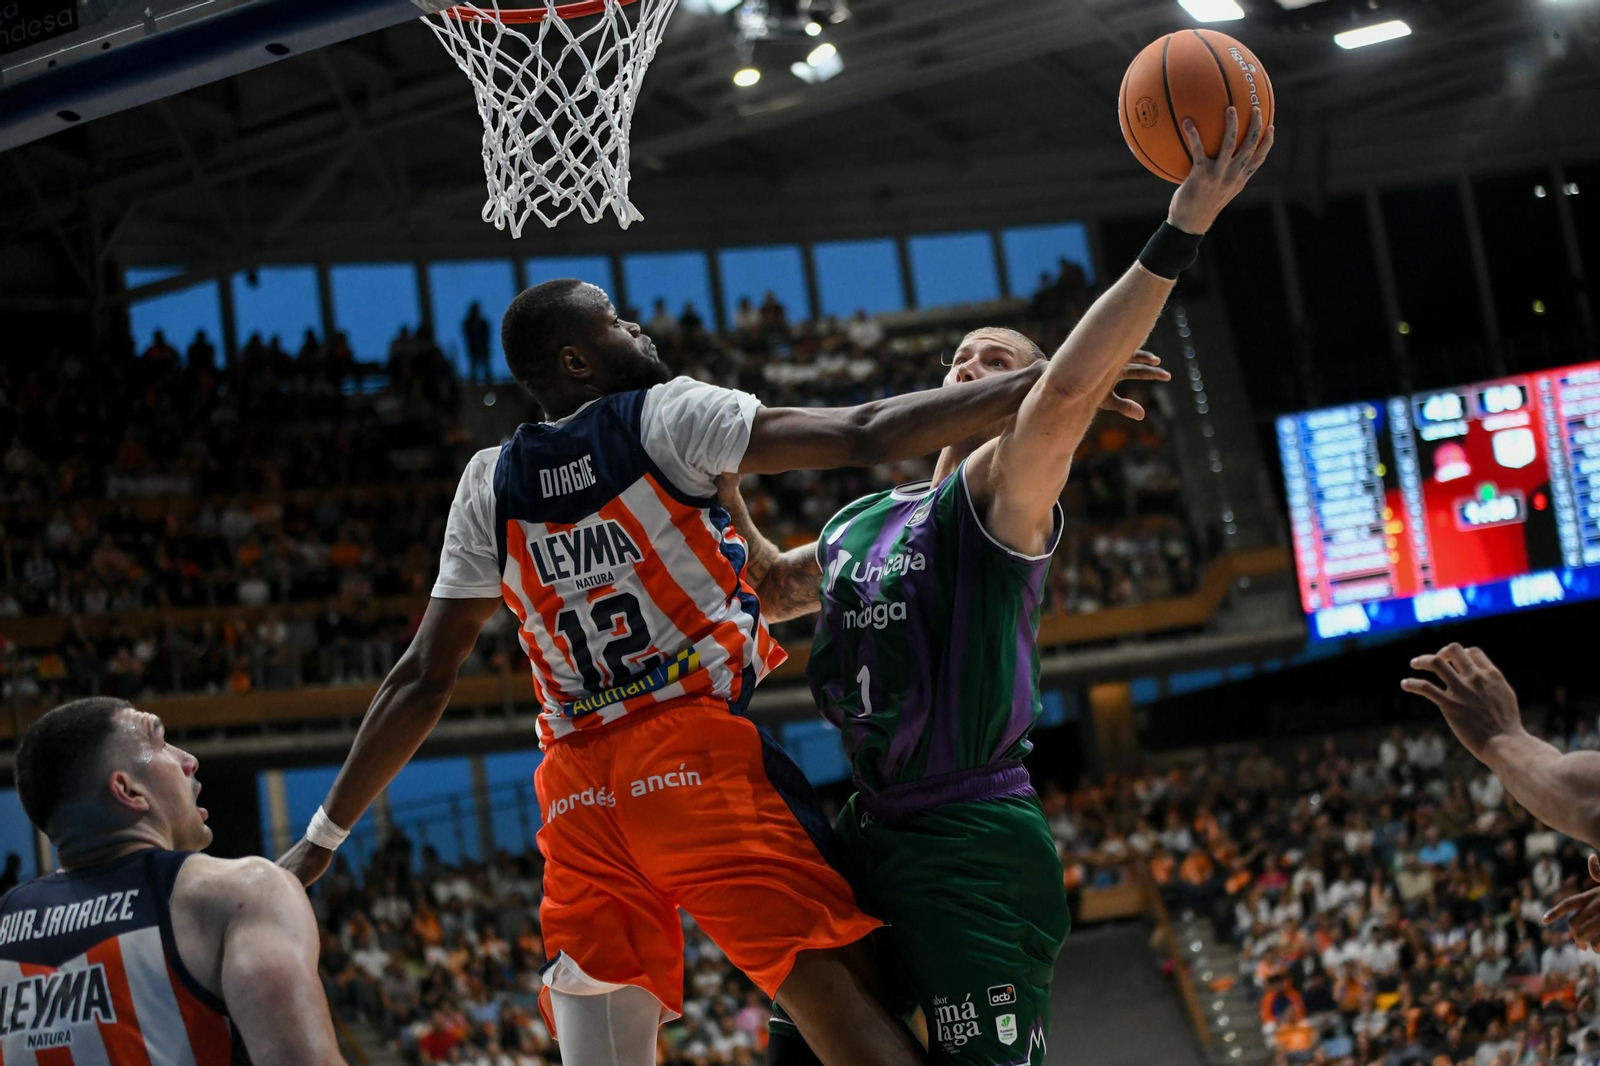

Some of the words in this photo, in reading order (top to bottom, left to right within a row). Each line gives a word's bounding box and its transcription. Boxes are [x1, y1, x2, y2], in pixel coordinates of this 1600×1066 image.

[539, 454, 596, 499] DIAGNE
[530, 521, 641, 585] LEYMA
[850, 547, 926, 583] Unicaja
[575, 571, 615, 590] NATURA
[558, 592, 662, 693] 12
[573, 675, 655, 715] Aluman
[856, 665, 872, 717] 1
[630, 764, 702, 798] ancín
[0, 889, 139, 946] BURJANADZE
[0, 966, 113, 1035] LEYMA
[992, 993, 1010, 1003] acb
[27, 1031, 72, 1049] NATURA
